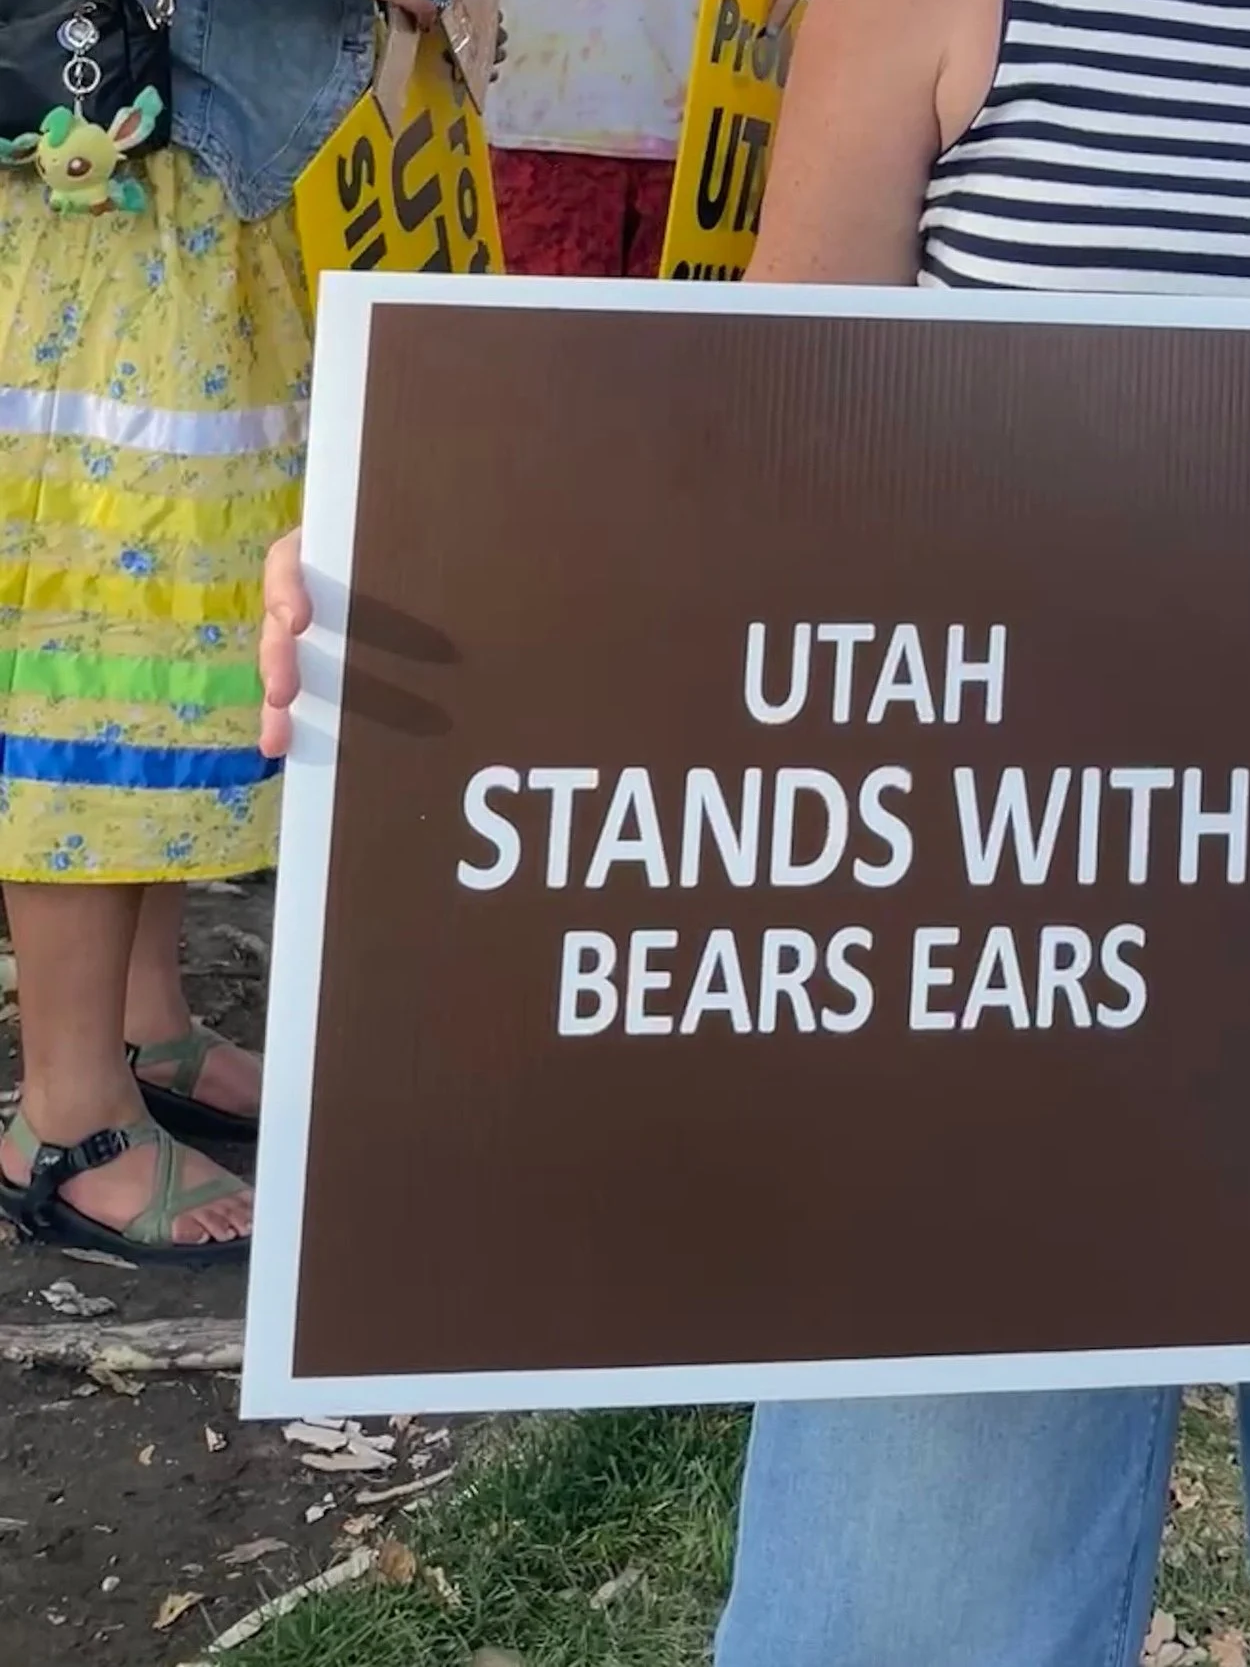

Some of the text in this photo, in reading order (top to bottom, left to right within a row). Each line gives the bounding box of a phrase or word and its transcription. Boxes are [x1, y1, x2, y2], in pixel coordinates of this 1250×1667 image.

[745, 623, 1005, 724] UTAH
[458, 766, 1249, 890] STANDS WITH
[559, 925, 1146, 1035] BEARS EARS
